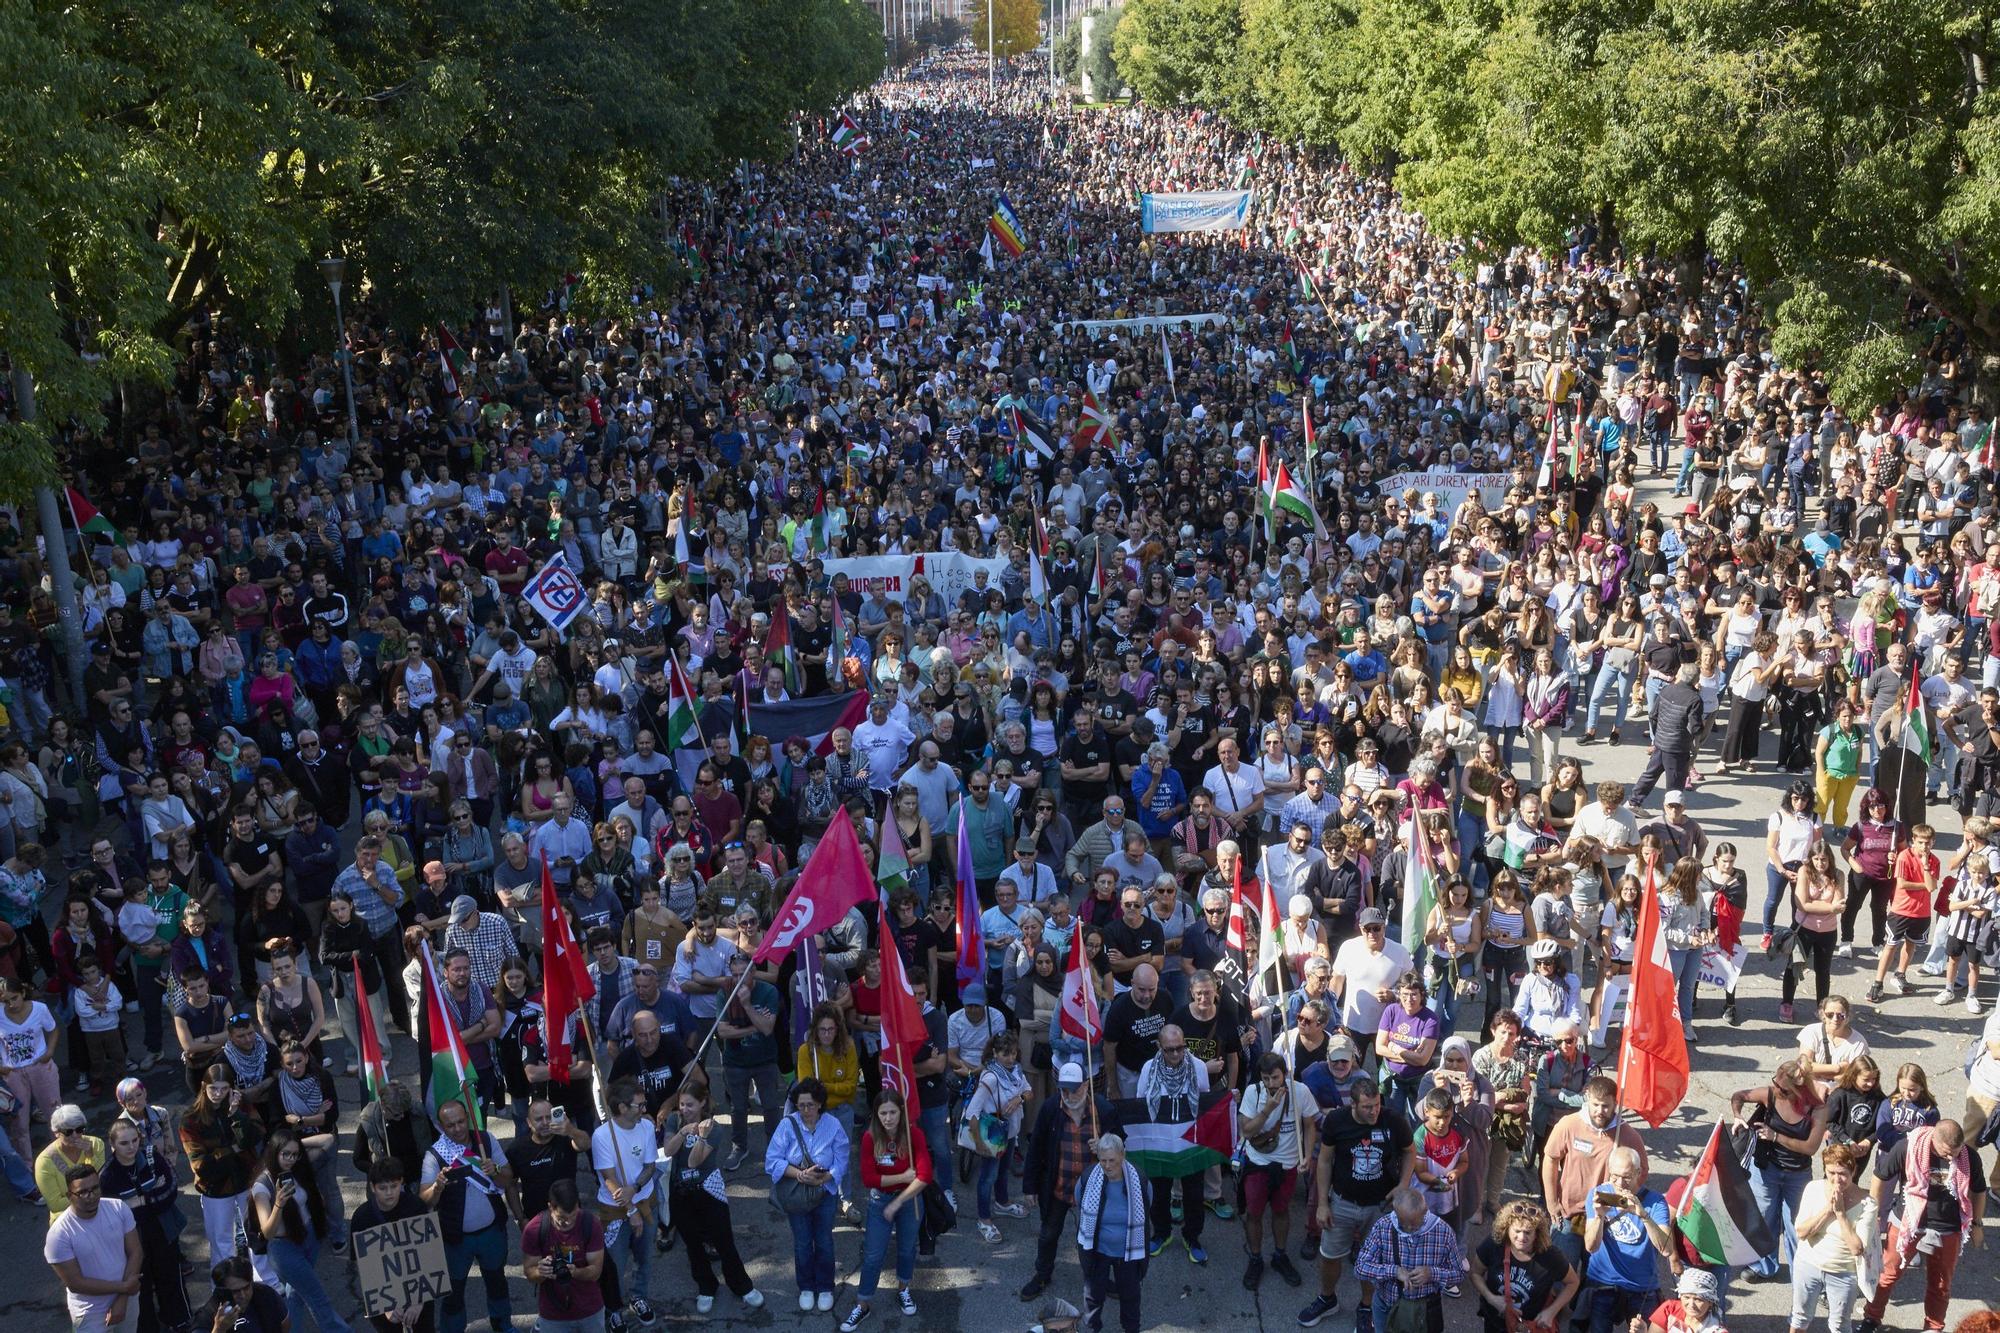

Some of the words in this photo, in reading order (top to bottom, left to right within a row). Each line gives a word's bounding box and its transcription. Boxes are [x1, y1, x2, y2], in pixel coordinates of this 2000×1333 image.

[1412, 475, 1430, 486] ARI
[1435, 475, 1469, 488] DIREN
[1474, 475, 1512, 488] HORIEK
[355, 1217, 439, 1259] PAUSA
[382, 1248, 422, 1283] NO
[365, 1283, 398, 1316] ES
[402, 1270, 452, 1312] PAZ
